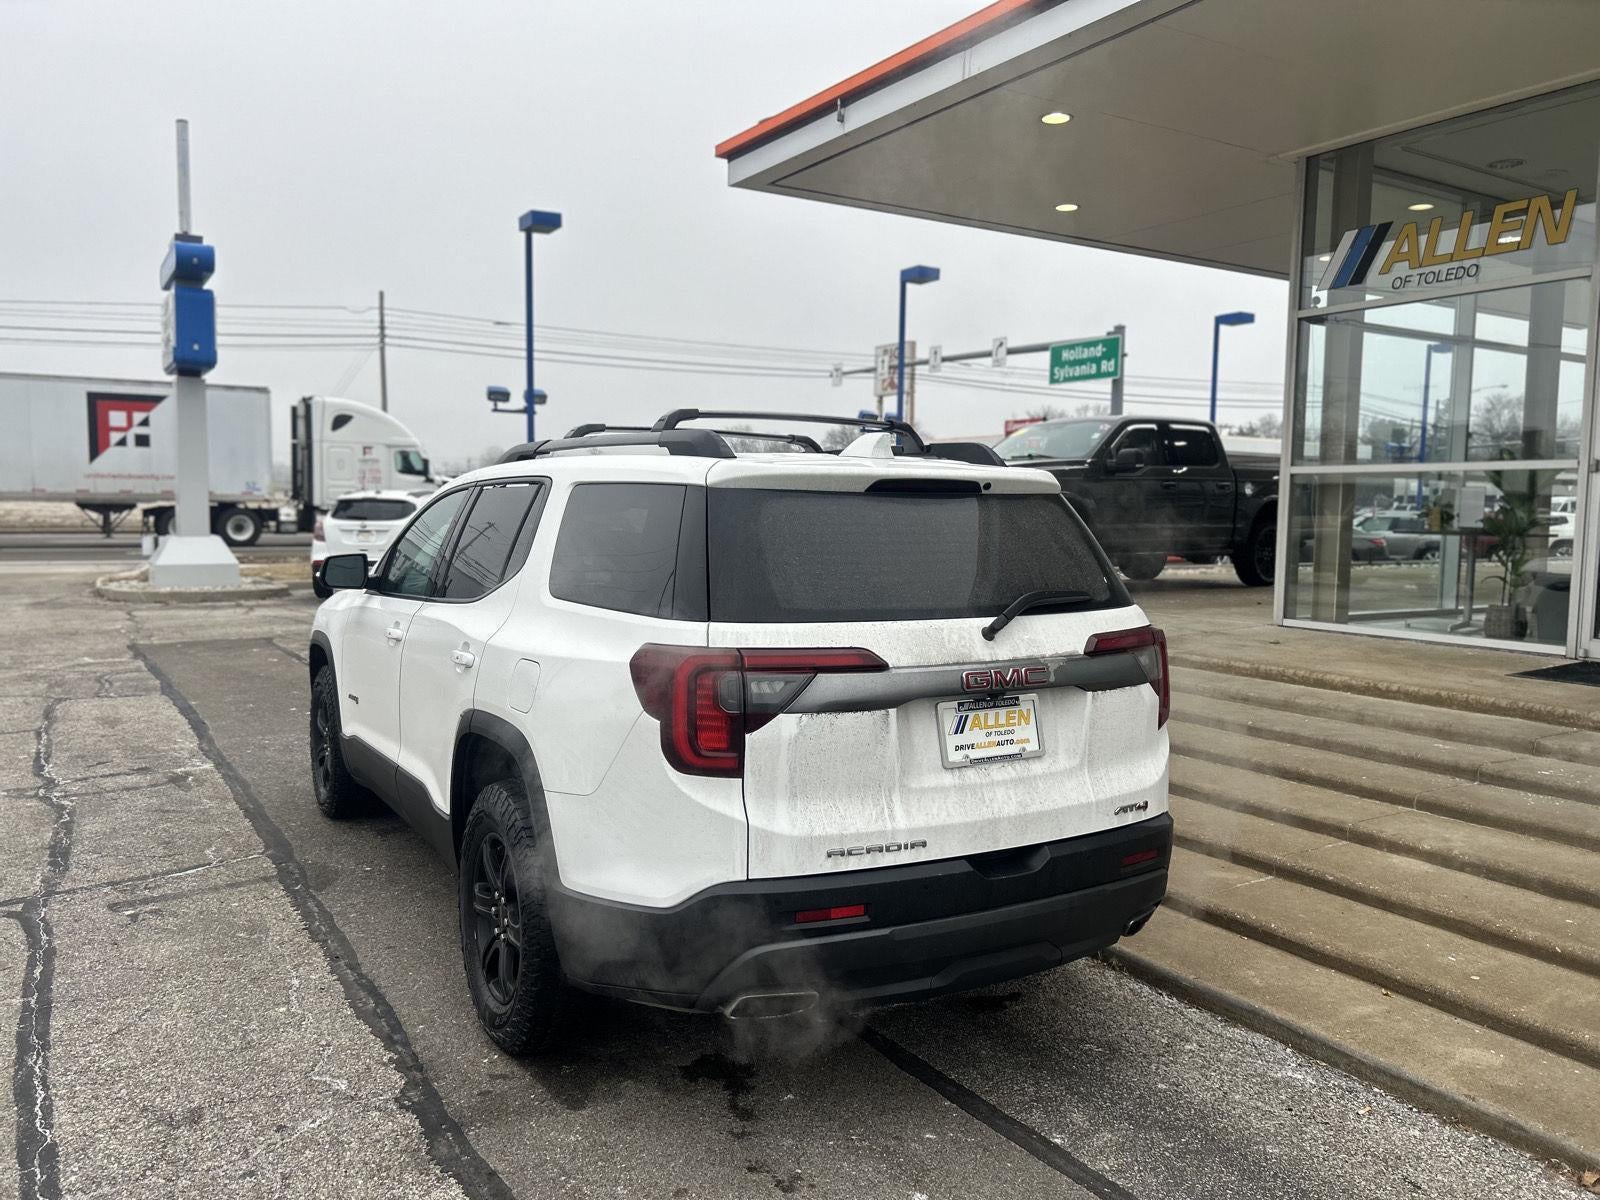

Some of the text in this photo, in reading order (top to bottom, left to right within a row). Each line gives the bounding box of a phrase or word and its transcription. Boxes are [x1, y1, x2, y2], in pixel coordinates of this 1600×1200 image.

[1378, 187, 1579, 275] ALLEN
[1391, 263, 1480, 290] OF TOLEDO
[1061, 343, 1107, 361] Holland-
[1053, 358, 1116, 382] Sylvania Rd
[962, 666, 1048, 691] GMC
[968, 701, 987, 710] ALLEN
[995, 699, 1016, 707] TOLEDO
[968, 708, 1031, 732] ALLEN
[994, 728, 1016, 737] TOLEDO
[826, 838, 928, 858] ACADIA
